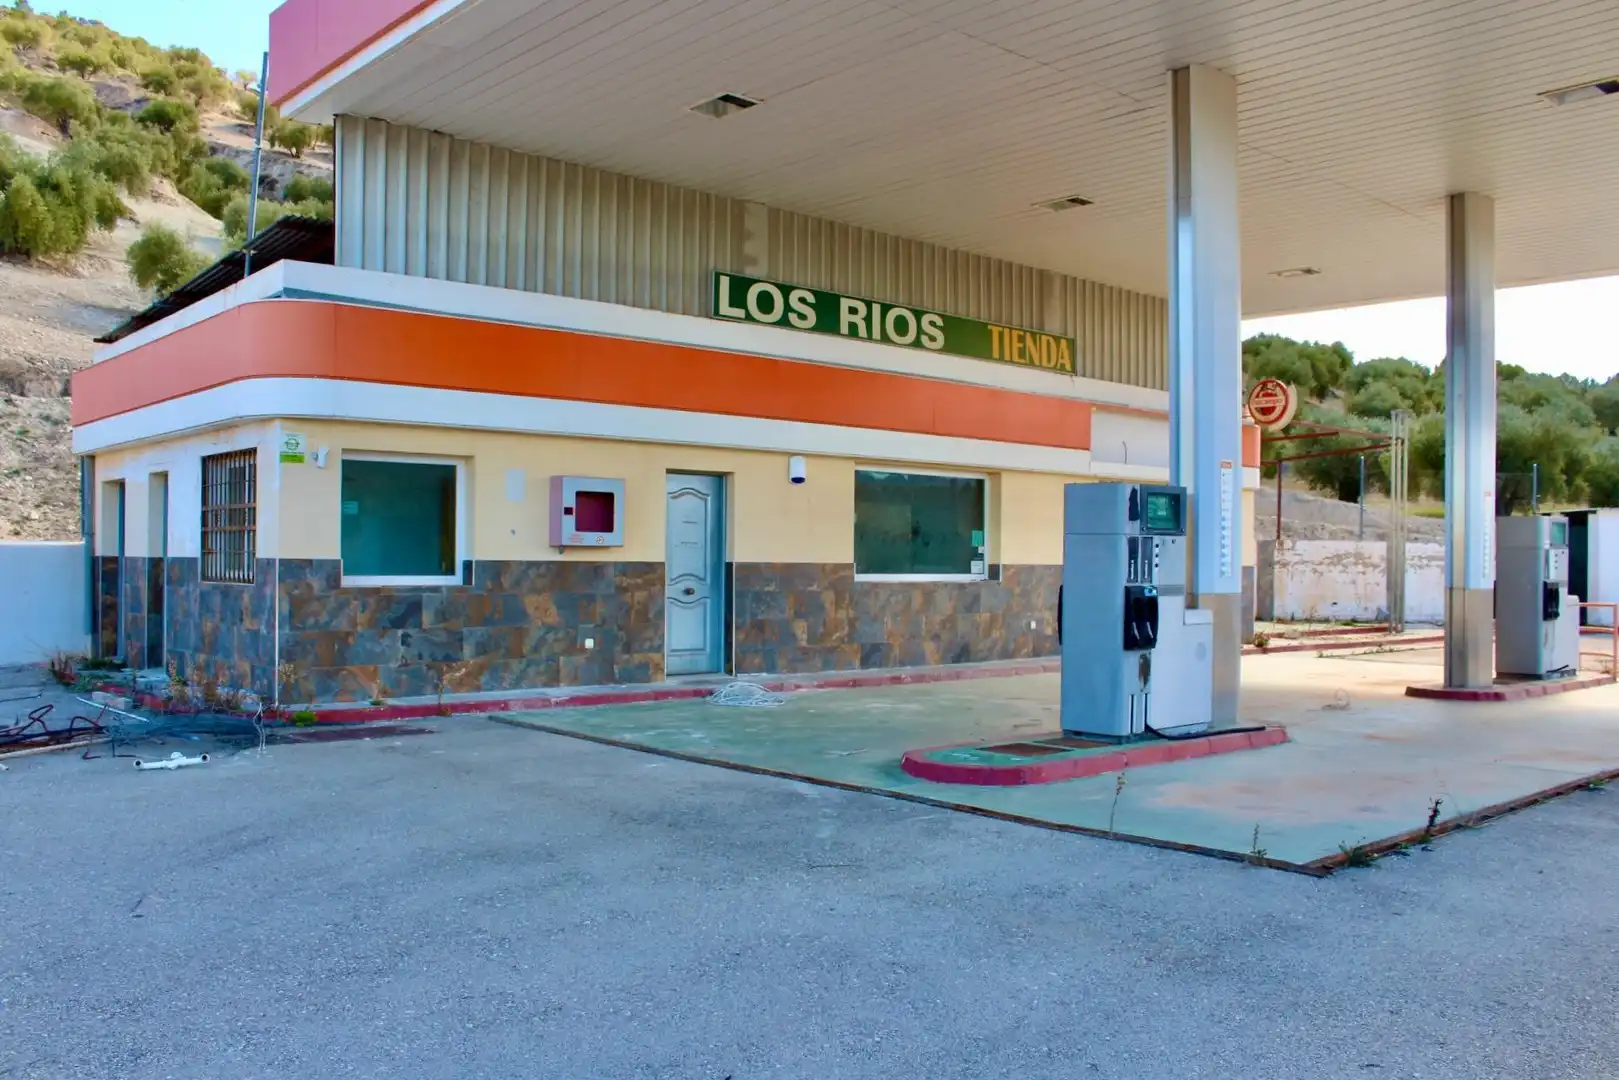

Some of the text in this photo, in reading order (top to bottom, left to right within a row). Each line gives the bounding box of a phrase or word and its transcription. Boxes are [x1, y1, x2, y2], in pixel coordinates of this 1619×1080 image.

[718, 275, 1072, 371] LOS RIOS TIENDA
